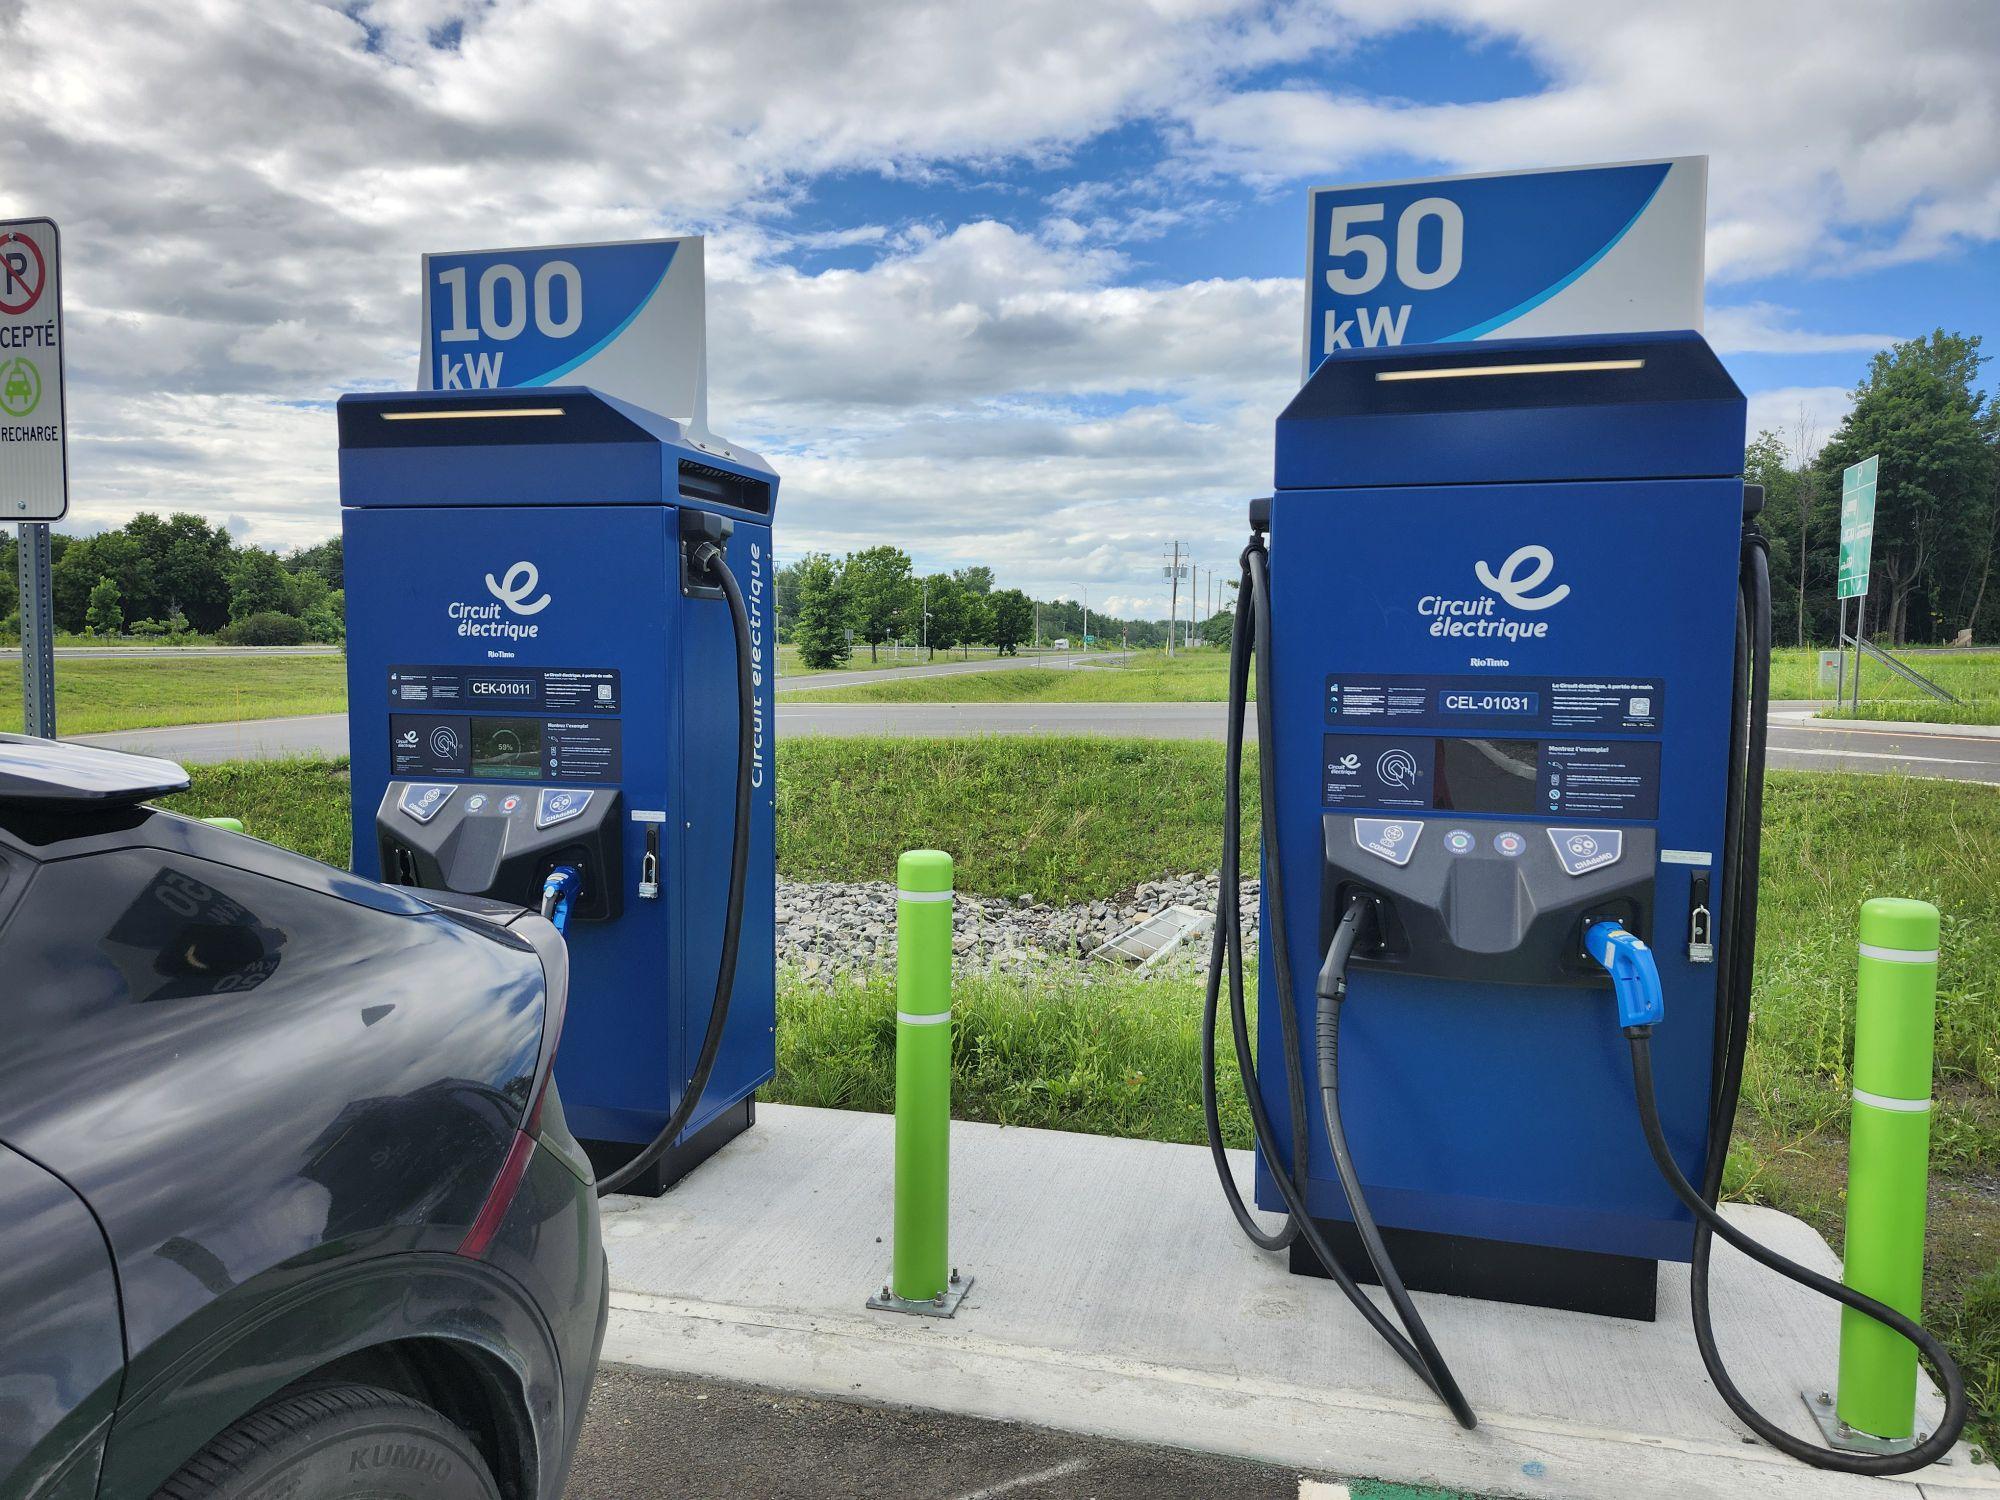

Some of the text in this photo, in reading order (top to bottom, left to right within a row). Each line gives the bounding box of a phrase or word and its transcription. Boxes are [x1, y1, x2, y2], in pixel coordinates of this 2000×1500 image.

[1325, 197, 1464, 296] 50
[438, 260, 583, 343] 100
[1323, 304, 1413, 354] kW
[441, 352, 504, 391] kW
[1, 425, 58, 442] RECHARGE
[447, 602, 502, 619] Circuit
[1417, 596, 1496, 616] Circuit
[457, 619, 539, 641] électrique
[1429, 616, 1548, 642] électrique
[473, 683, 530, 695] CEK-01011
[1446, 695, 1528, 710] CEL-01031
[498, 743, 513, 751] 59%
[345, 1444, 452, 1482] KUMHO
